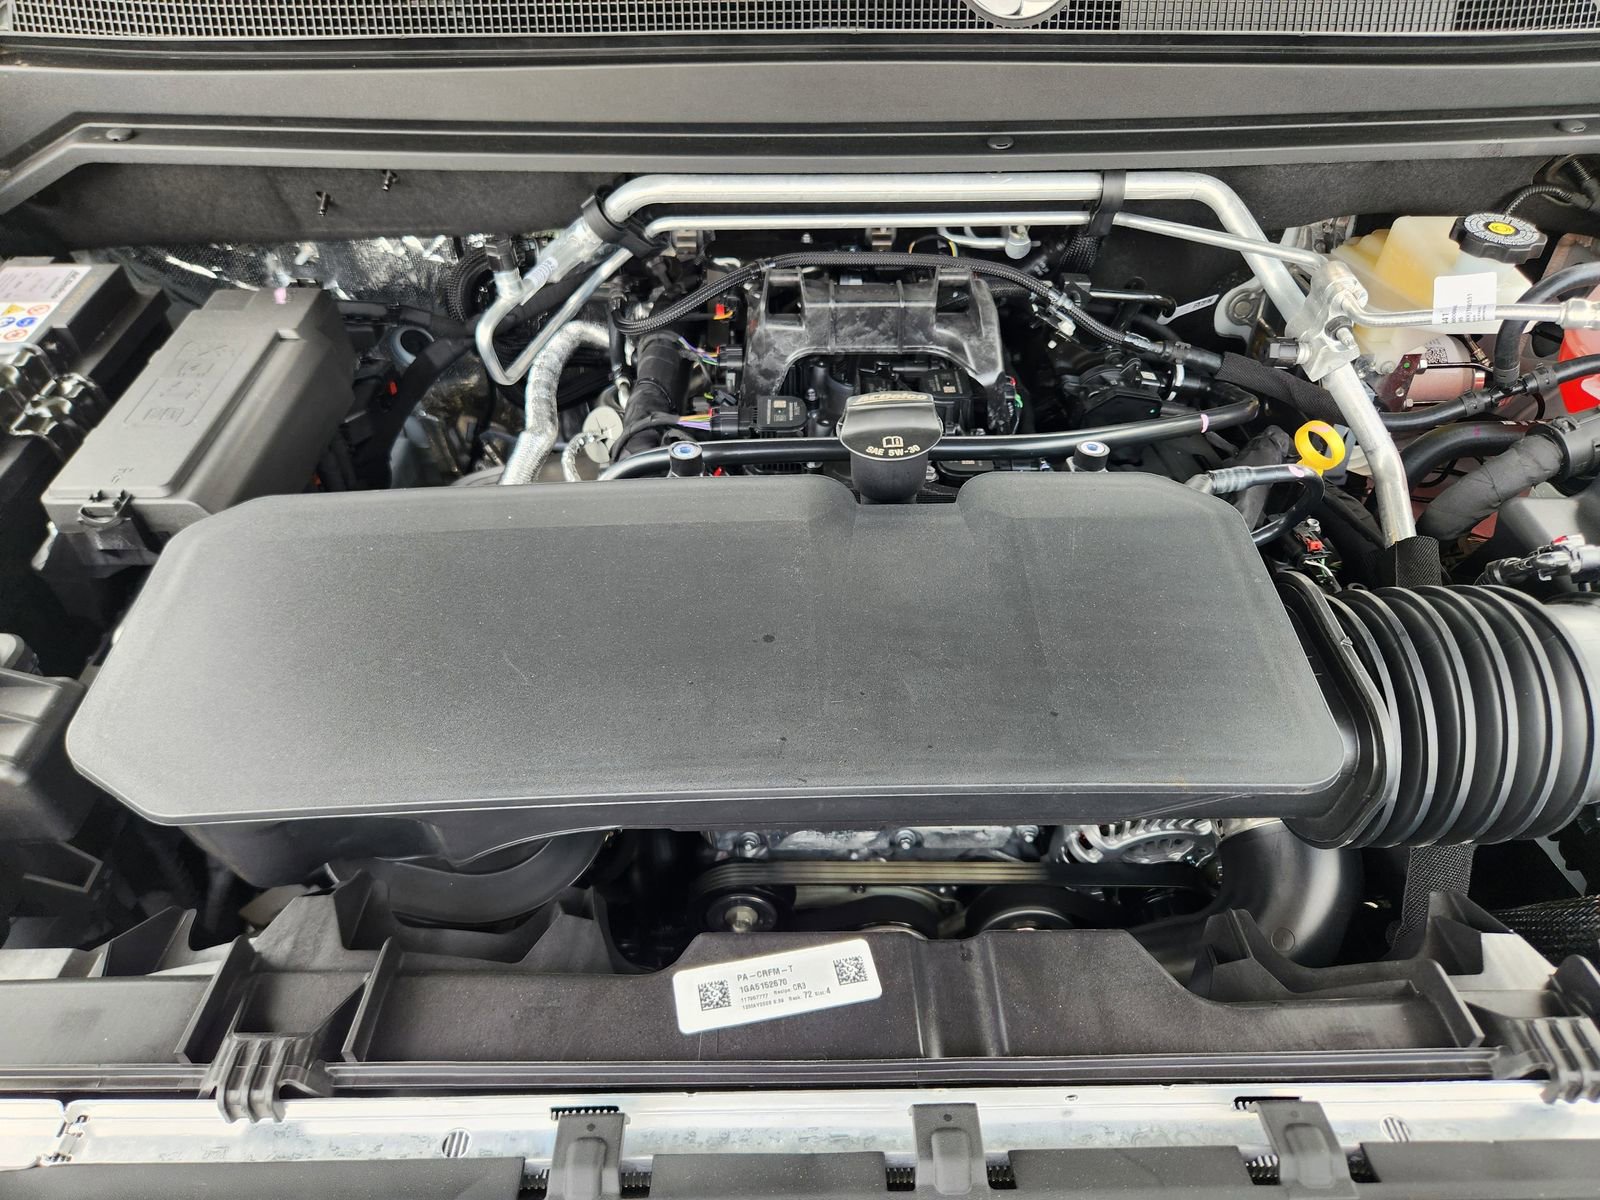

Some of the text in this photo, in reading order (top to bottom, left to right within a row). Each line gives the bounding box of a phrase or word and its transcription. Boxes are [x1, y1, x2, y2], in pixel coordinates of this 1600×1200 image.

[866, 444, 921, 457] SAE 5W-30
[792, 982, 807, 991] CR3
[803, 990, 813, 999] 72
[826, 986, 831, 994] 4
